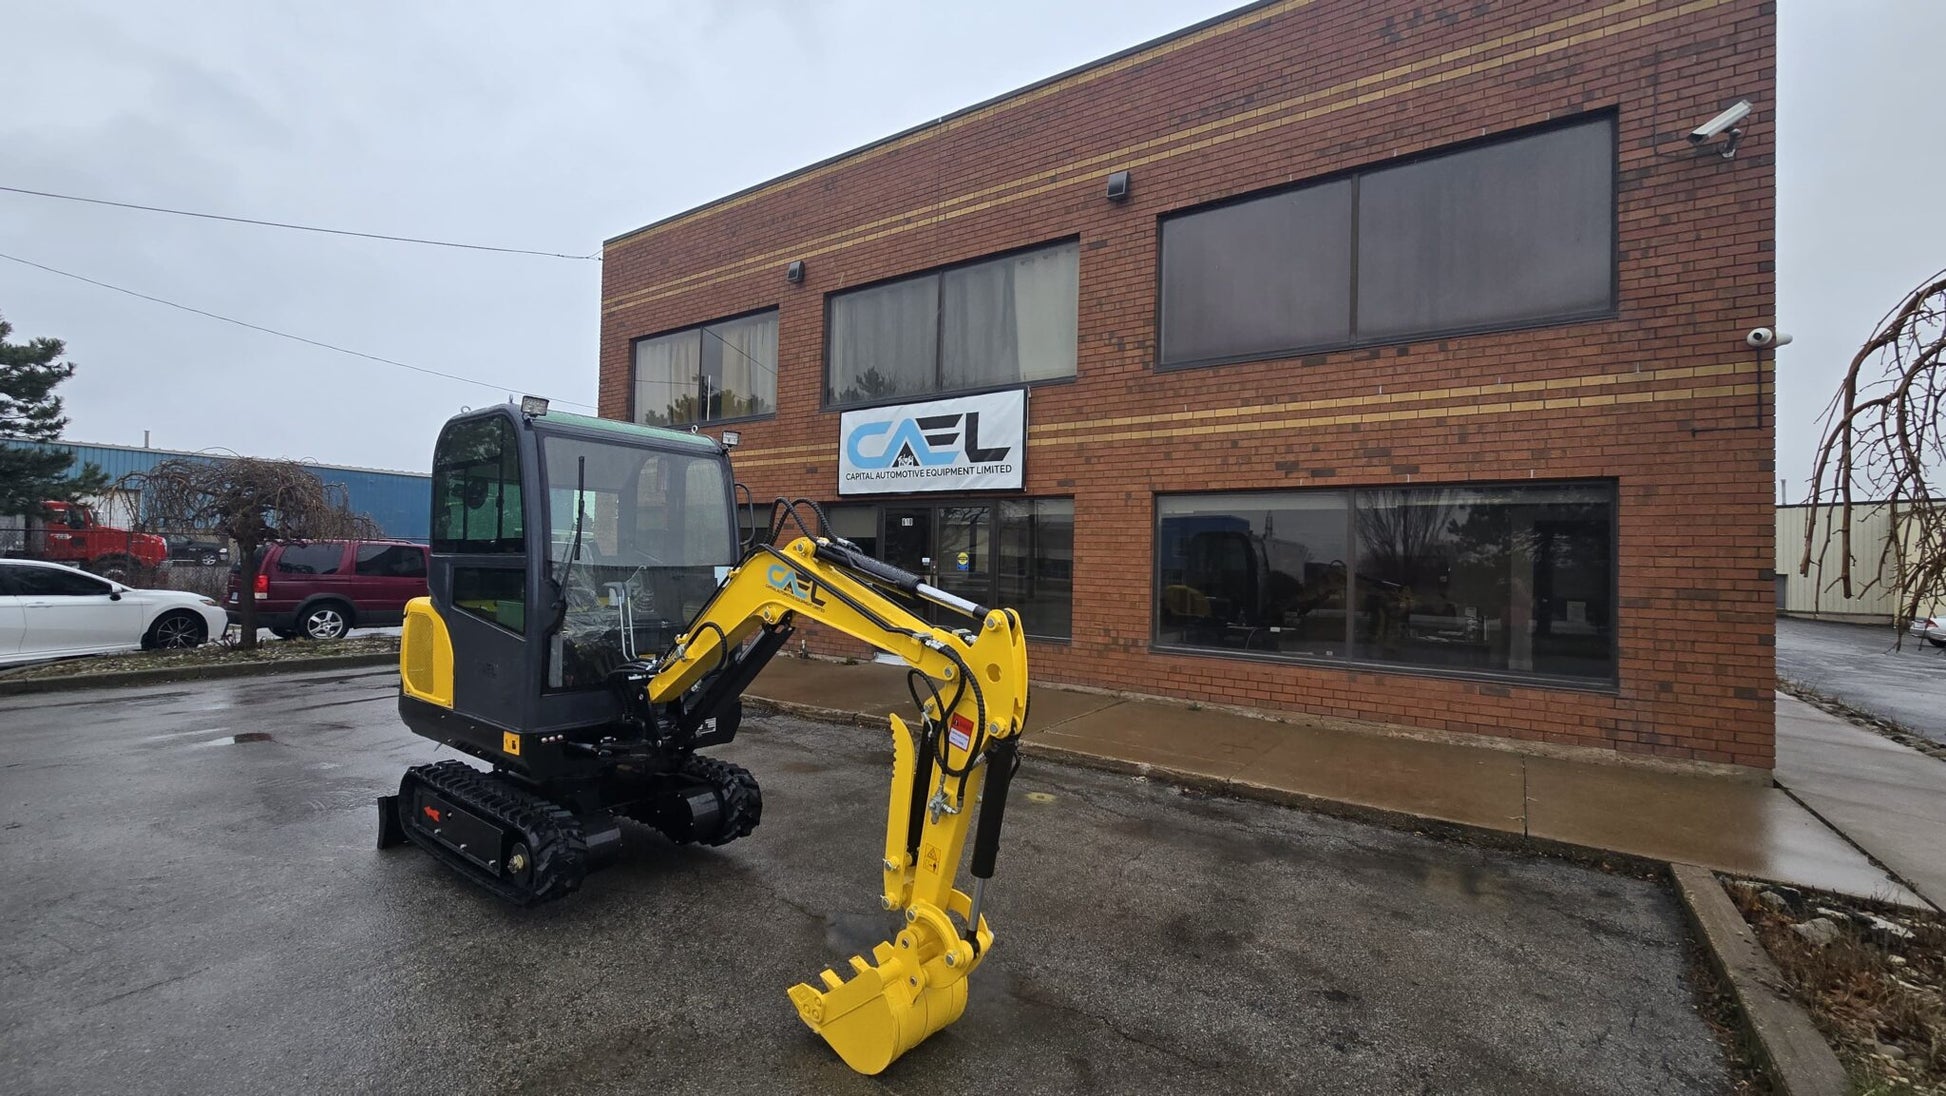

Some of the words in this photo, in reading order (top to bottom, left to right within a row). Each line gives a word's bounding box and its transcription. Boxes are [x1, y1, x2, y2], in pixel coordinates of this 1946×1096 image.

[847, 412, 1011, 469] CAEL
[846, 470, 874, 481] CAPITAL
[875, 468, 925, 480] AUTOMOTIVE
[926, 466, 975, 478] EQUIPMENT
[976, 464, 1013, 475] LIMITED
